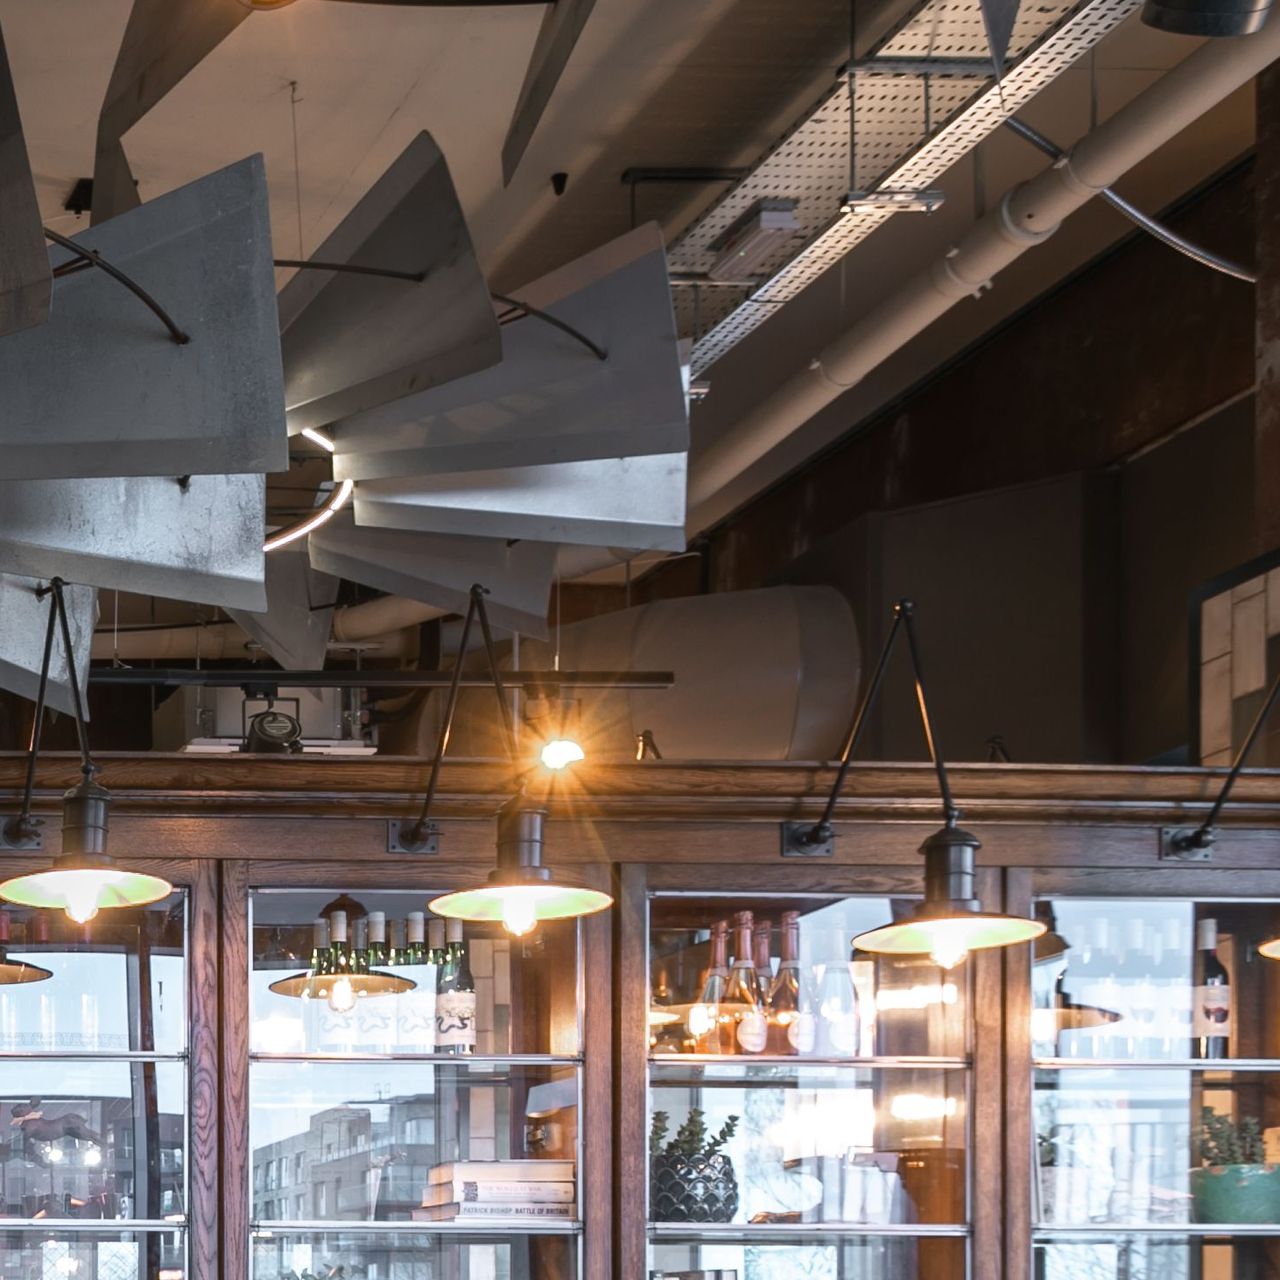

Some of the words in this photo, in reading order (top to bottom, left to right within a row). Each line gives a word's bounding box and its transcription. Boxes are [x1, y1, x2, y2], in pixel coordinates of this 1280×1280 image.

[515, 1207, 535, 1215] BATTLE
[536, 1207, 544, 1215] OF
[546, 1207, 569, 1215] BRITAIN
